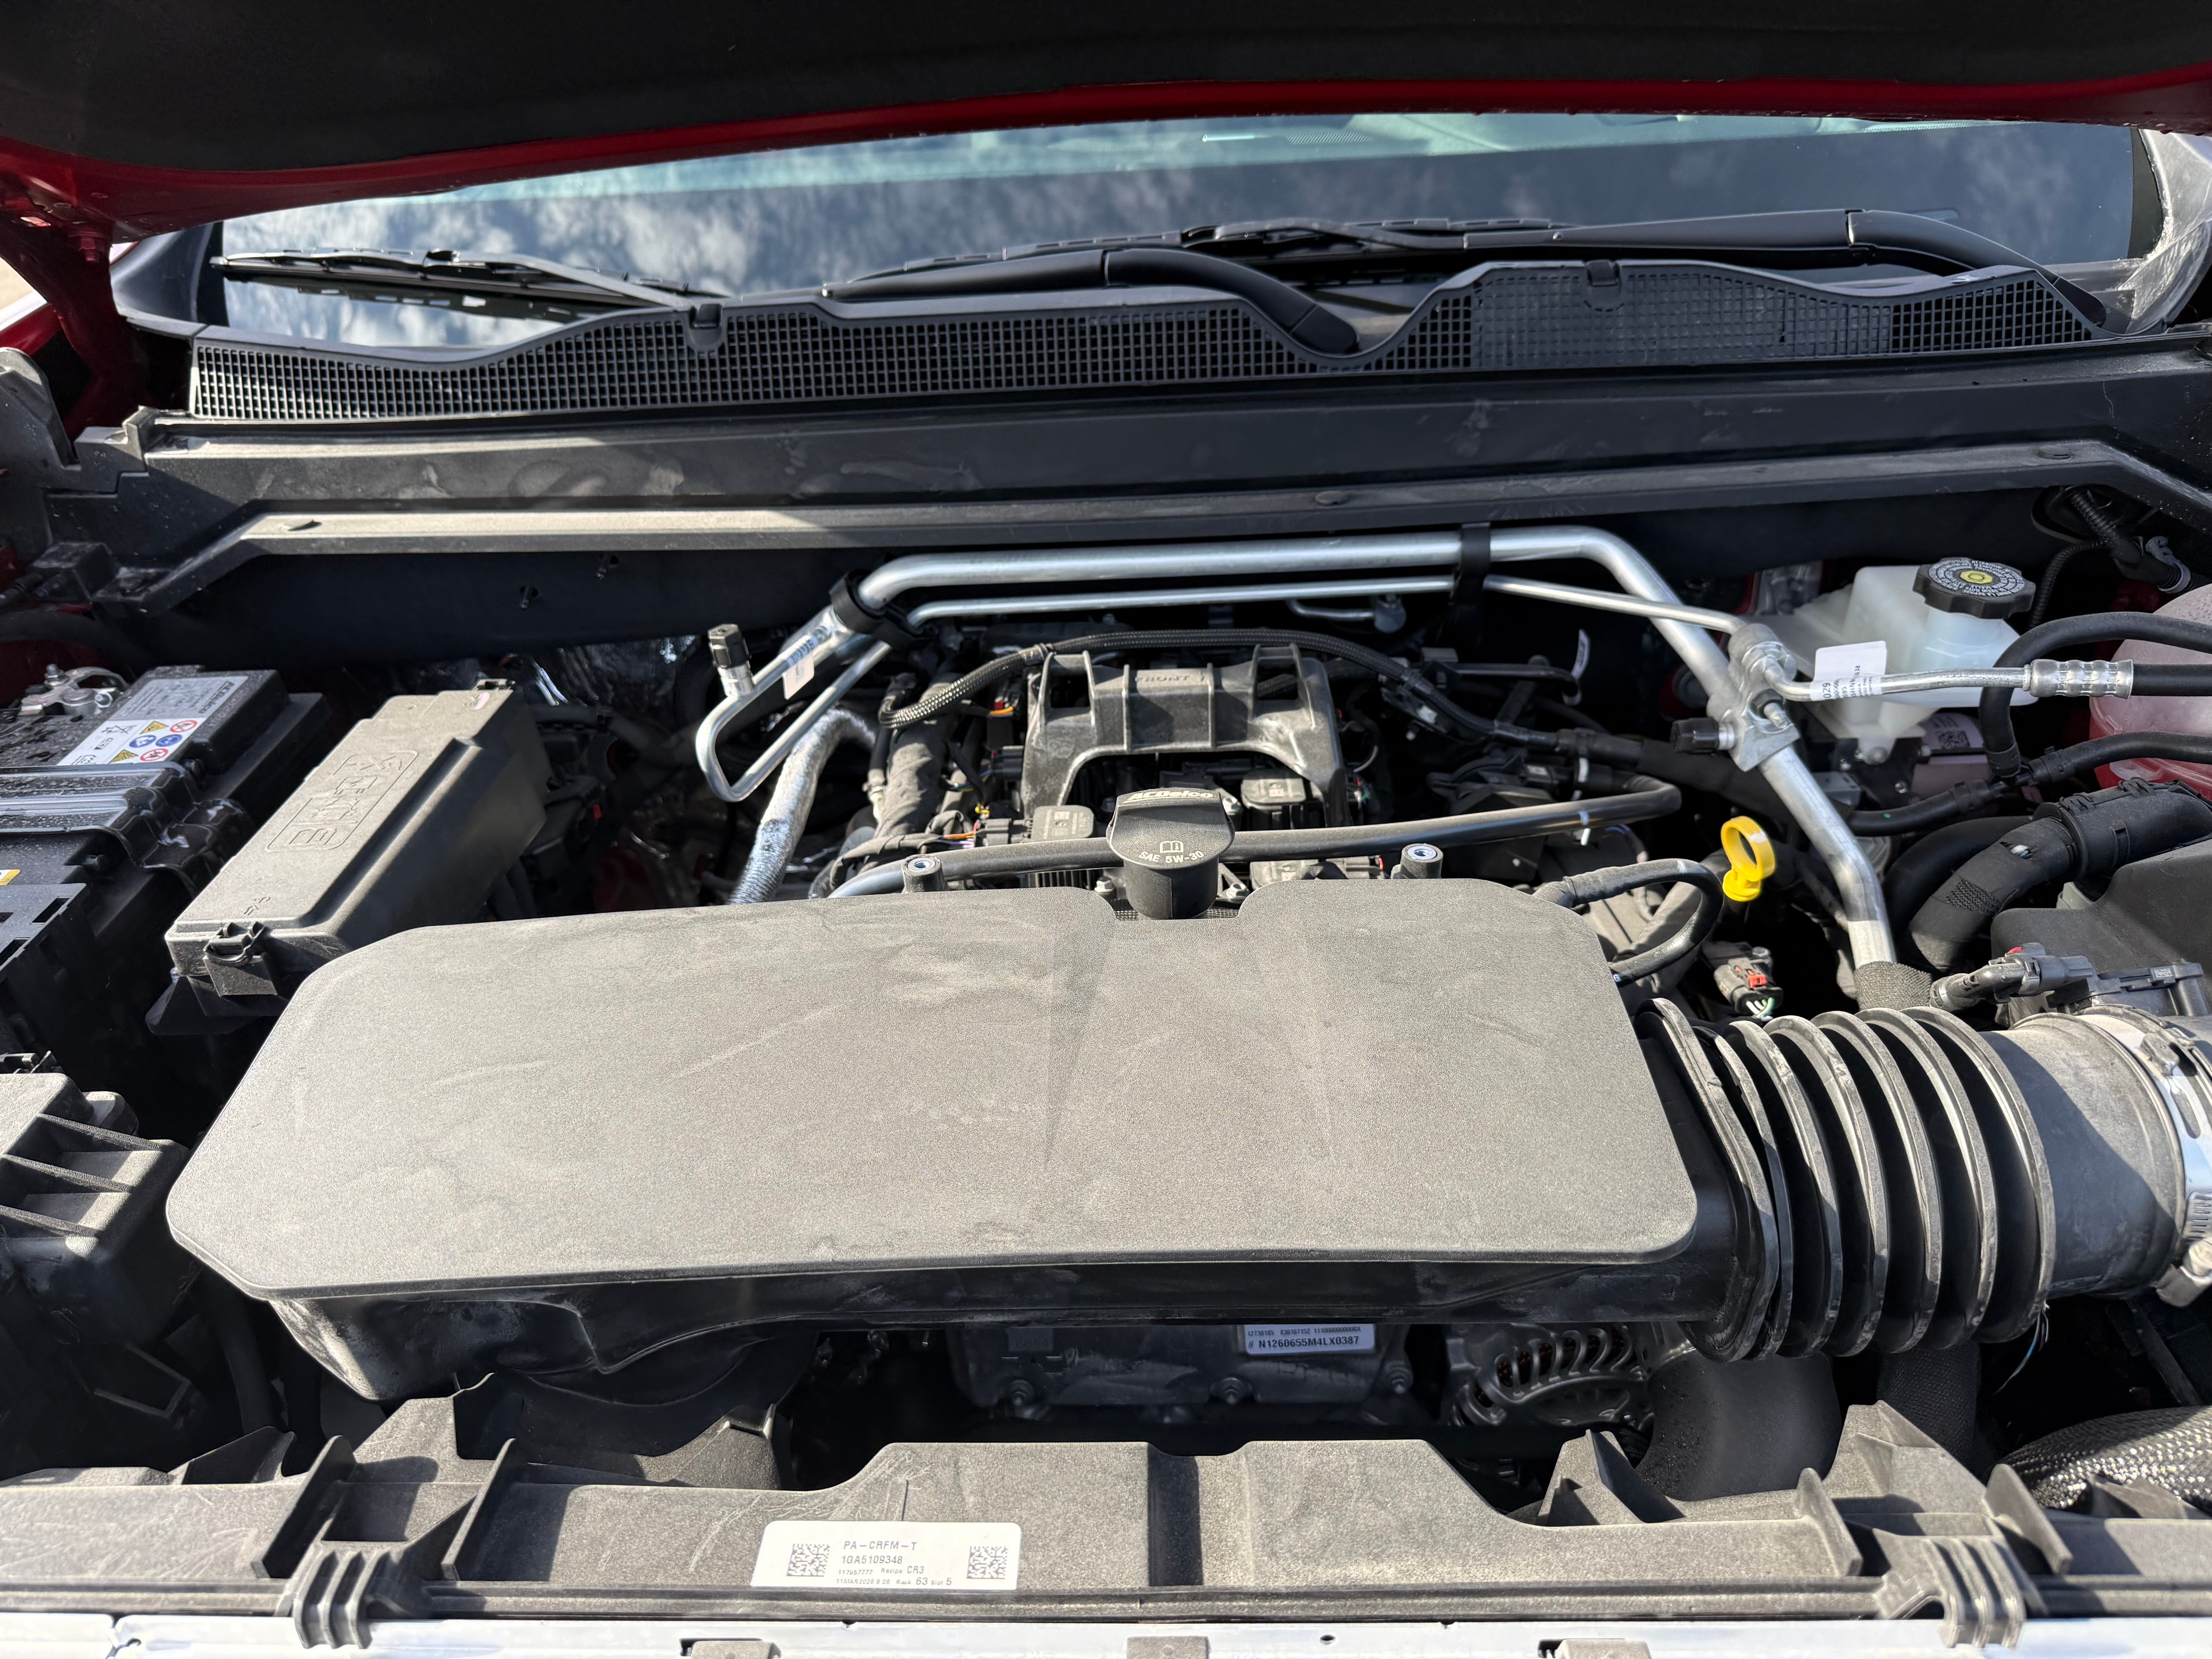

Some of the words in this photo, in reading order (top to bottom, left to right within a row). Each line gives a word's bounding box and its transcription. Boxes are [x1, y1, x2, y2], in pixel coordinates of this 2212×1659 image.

[1127, 790, 1214, 800] ACDelco
[1139, 851, 1161, 862] SAE
[1165, 850, 1204, 864] 5W-30
[841, 1555, 903, 1564] 1GA5109348
[907, 1566, 924, 1574] CR3
[916, 1577, 928, 1585] 63
[946, 1577, 952, 1585] 5
